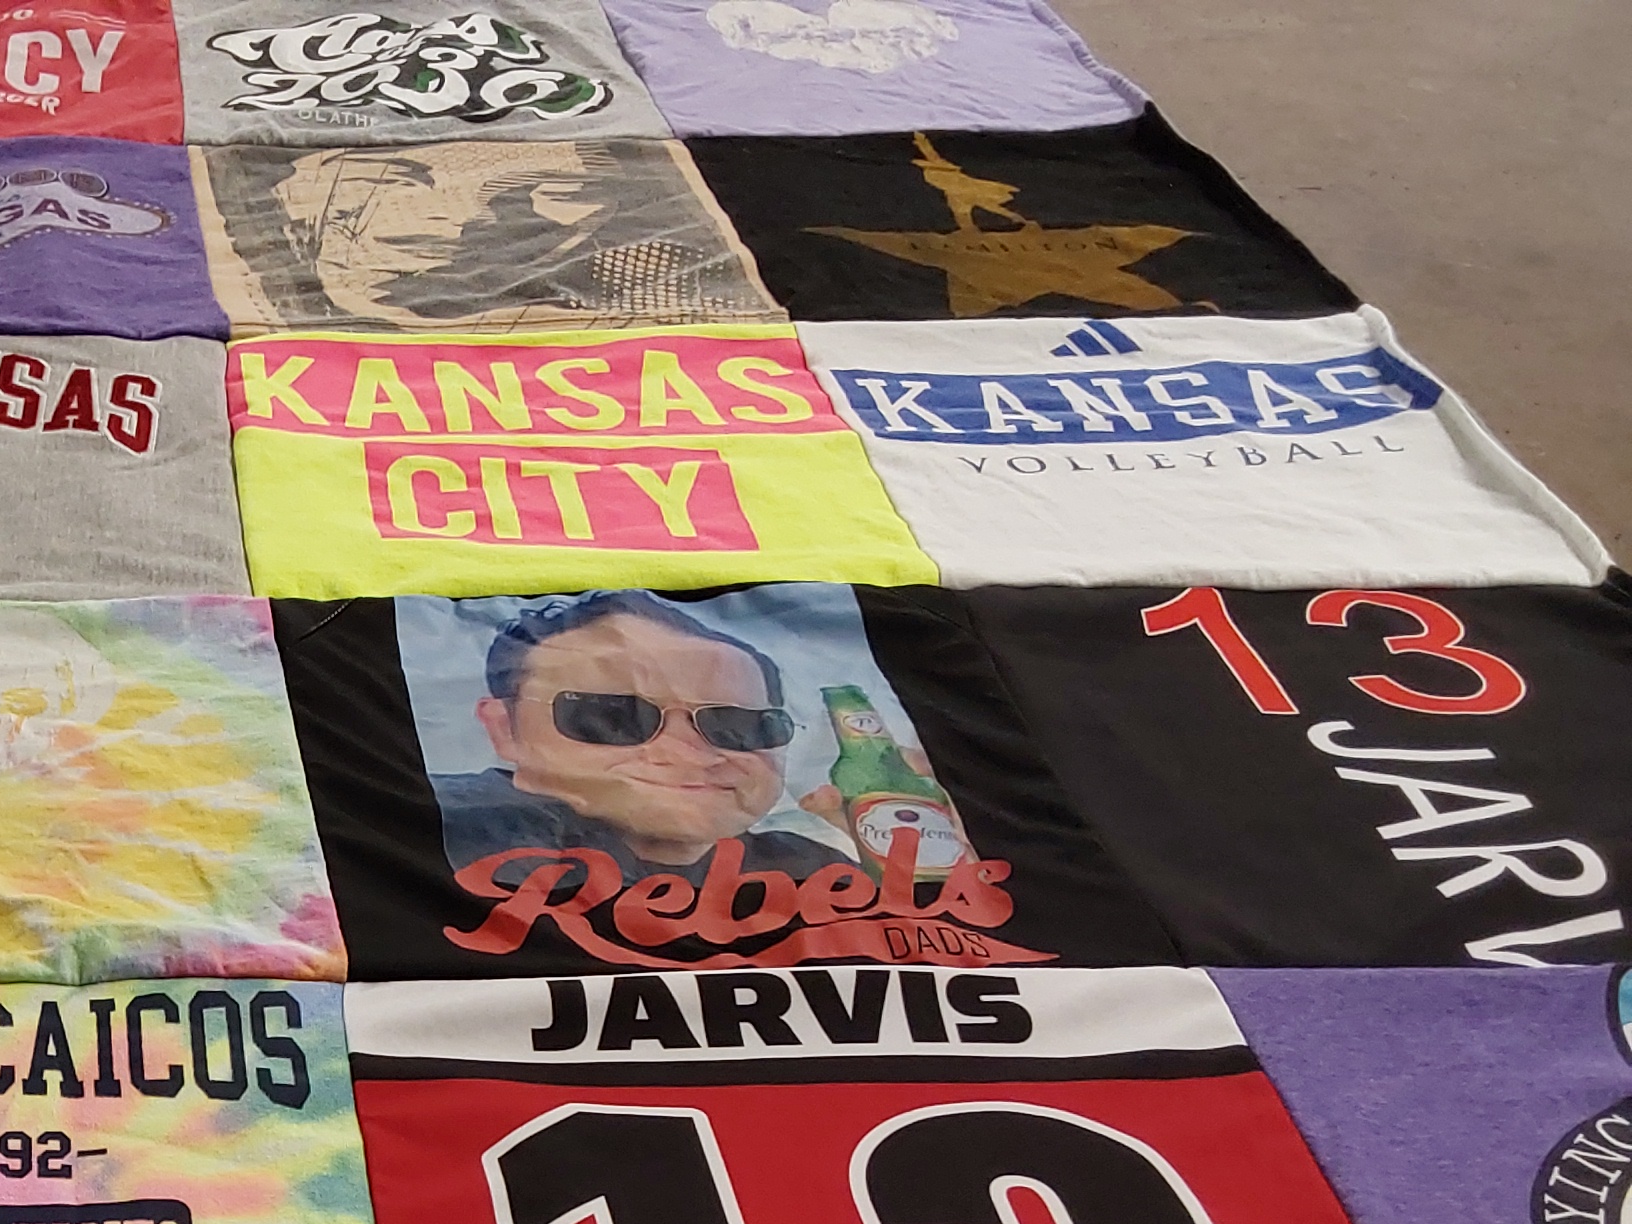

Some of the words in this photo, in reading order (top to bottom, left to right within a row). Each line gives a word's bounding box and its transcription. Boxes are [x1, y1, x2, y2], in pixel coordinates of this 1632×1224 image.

[239, 350, 814, 433] KANSAS
[855, 362, 1414, 436] KANSAS
[957, 434, 1406, 474] VOLLEYBALL
[385, 455, 700, 540] CITY
[1140, 586, 1527, 714] 13
[443, 838, 1016, 966] Rebels
[883, 926, 991, 960] DADS
[531, 969, 1034, 1052] JARVIS
